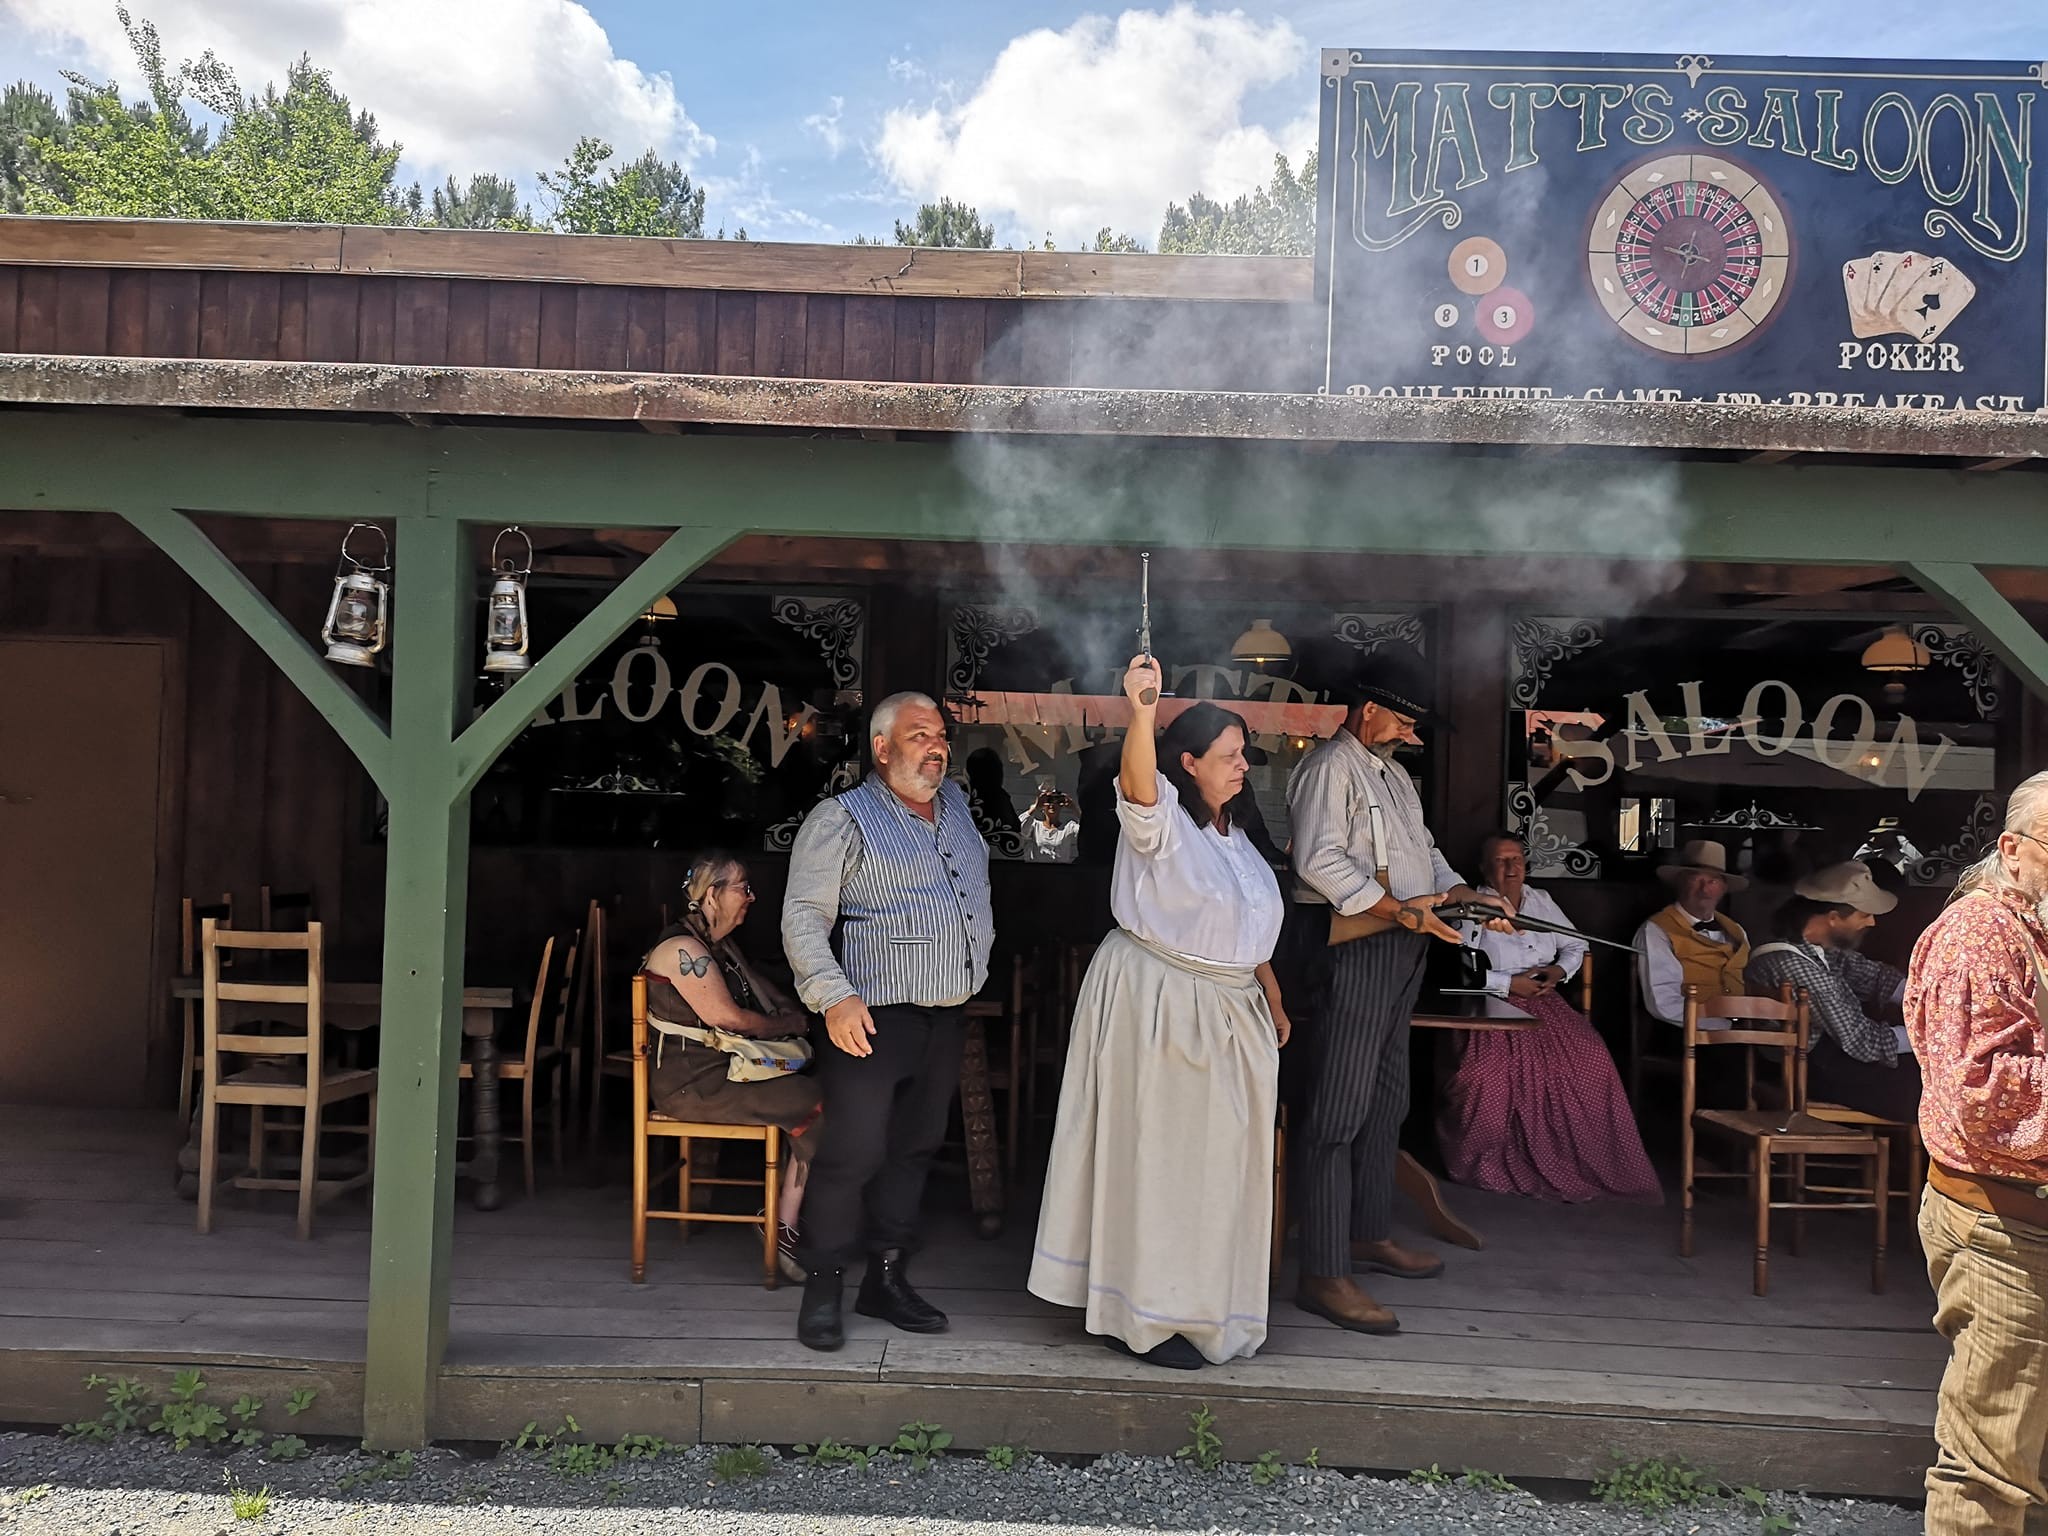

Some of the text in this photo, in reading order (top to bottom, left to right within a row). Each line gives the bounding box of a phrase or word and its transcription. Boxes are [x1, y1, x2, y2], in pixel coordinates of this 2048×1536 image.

[1352, 80, 2035, 262] MATT'S SALOON
[1473, 258, 1480, 273] 1
[1902, 254, 1913, 267] A
[1846, 263, 1857, 275] A
[1442, 308, 1451, 323] 8
[1501, 311, 1508, 324] 3
[1430, 345, 1517, 368] POOL
[1837, 341, 1965, 373] POKER
[1551, 679, 1957, 803] SALOON
